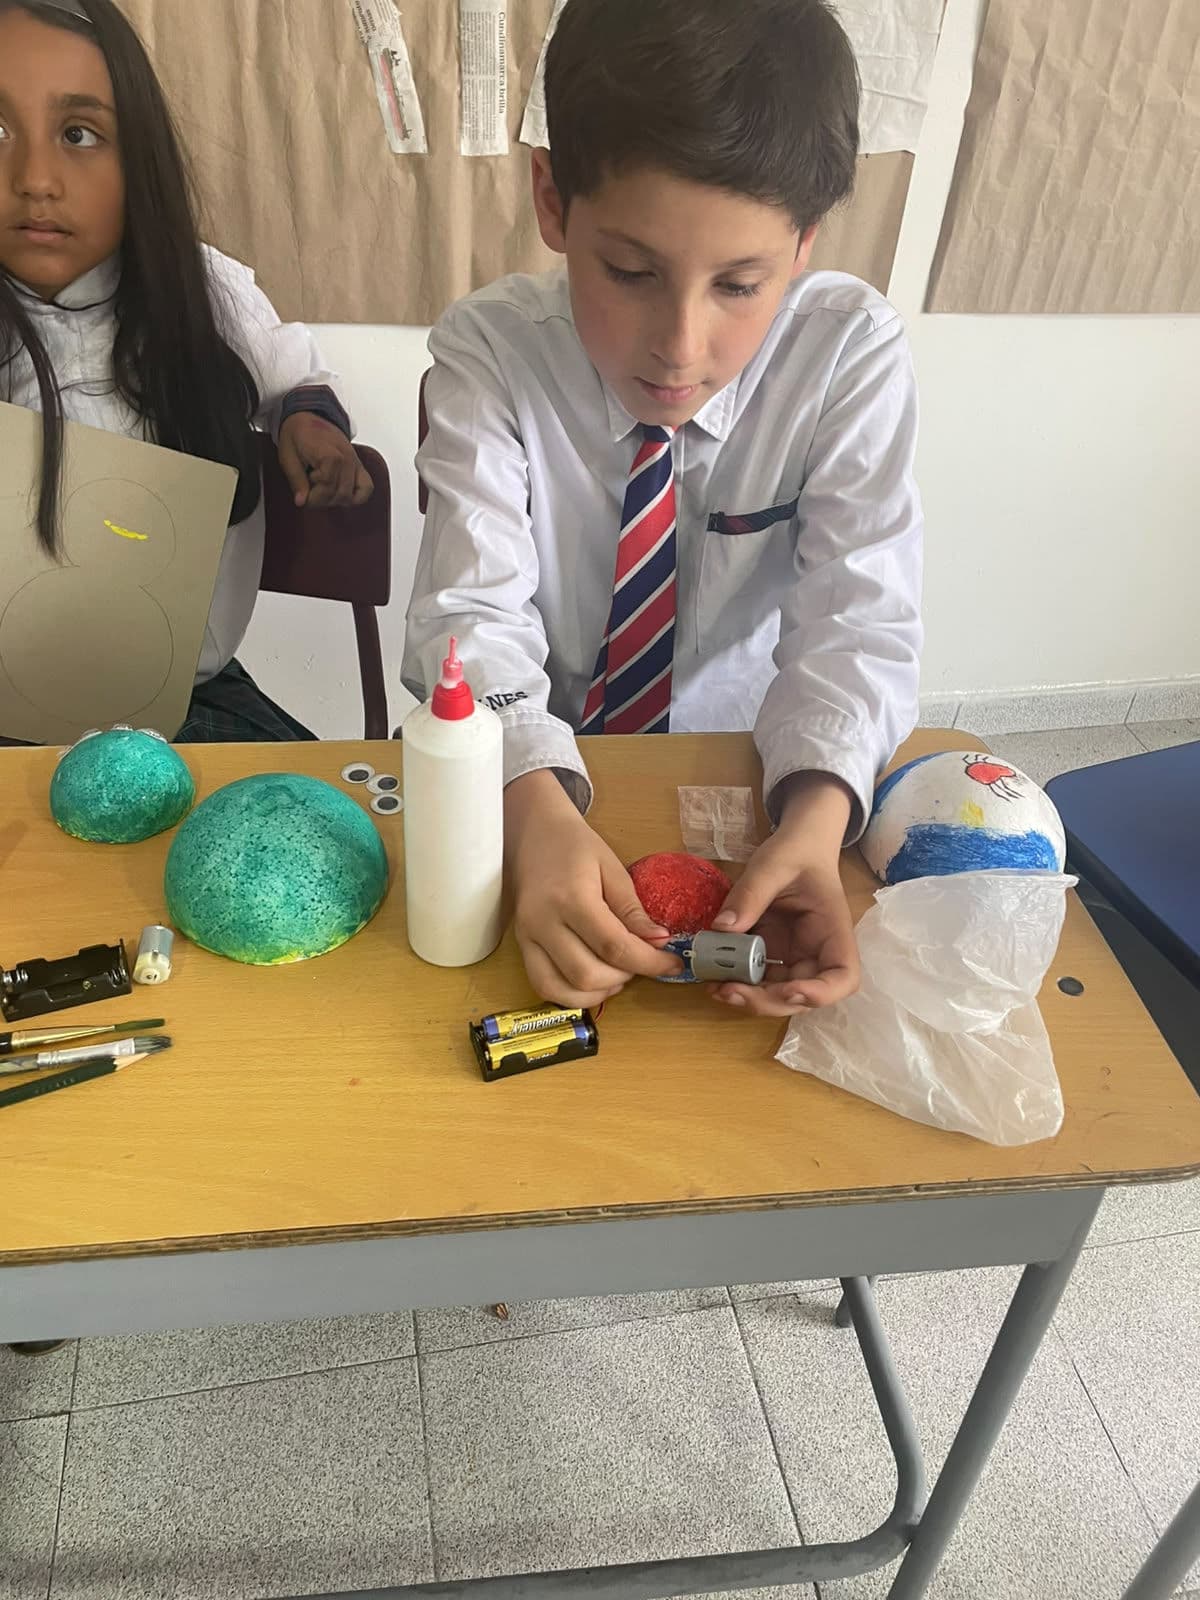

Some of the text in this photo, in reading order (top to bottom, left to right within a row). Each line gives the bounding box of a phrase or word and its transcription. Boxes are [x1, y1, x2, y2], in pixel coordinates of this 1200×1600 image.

[498, 11, 506, 114] Cundinamarca brilla
[478, 691, 528, 711] NES
